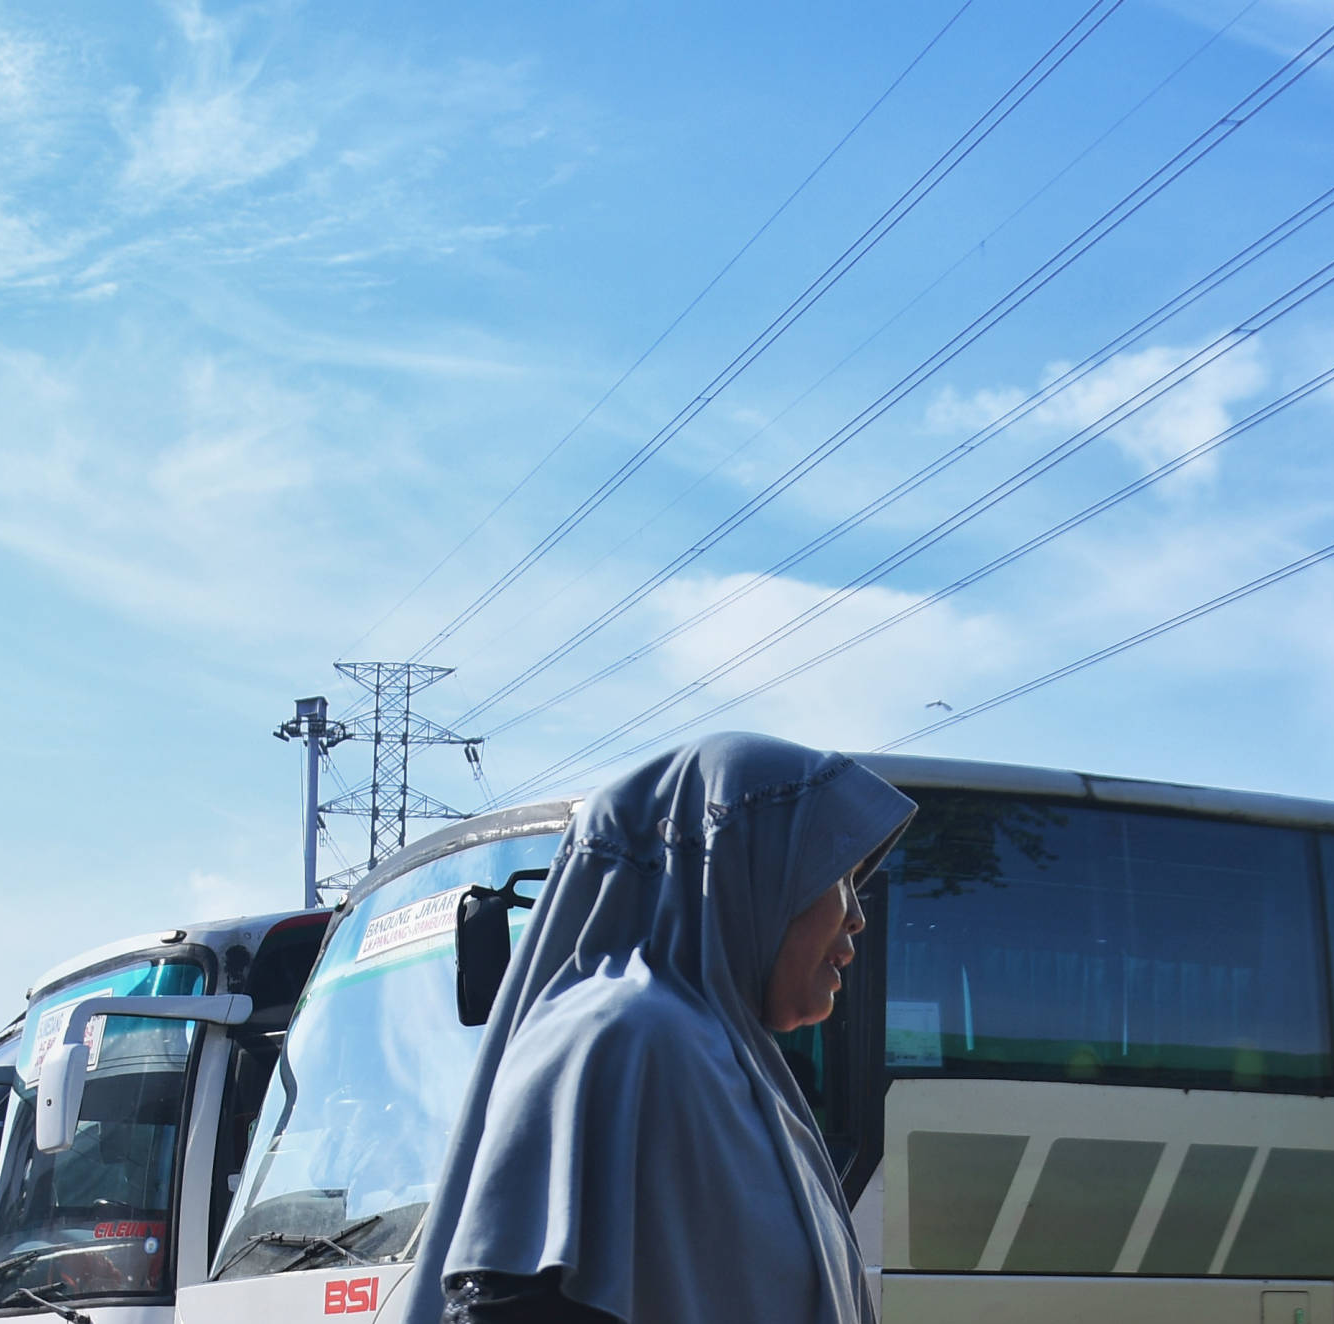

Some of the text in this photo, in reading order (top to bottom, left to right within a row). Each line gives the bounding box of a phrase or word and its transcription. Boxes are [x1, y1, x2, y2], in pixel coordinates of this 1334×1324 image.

[366, 893, 459, 938] BANDUNG JAKAR
[324, 1277, 379, 1315] BSI
